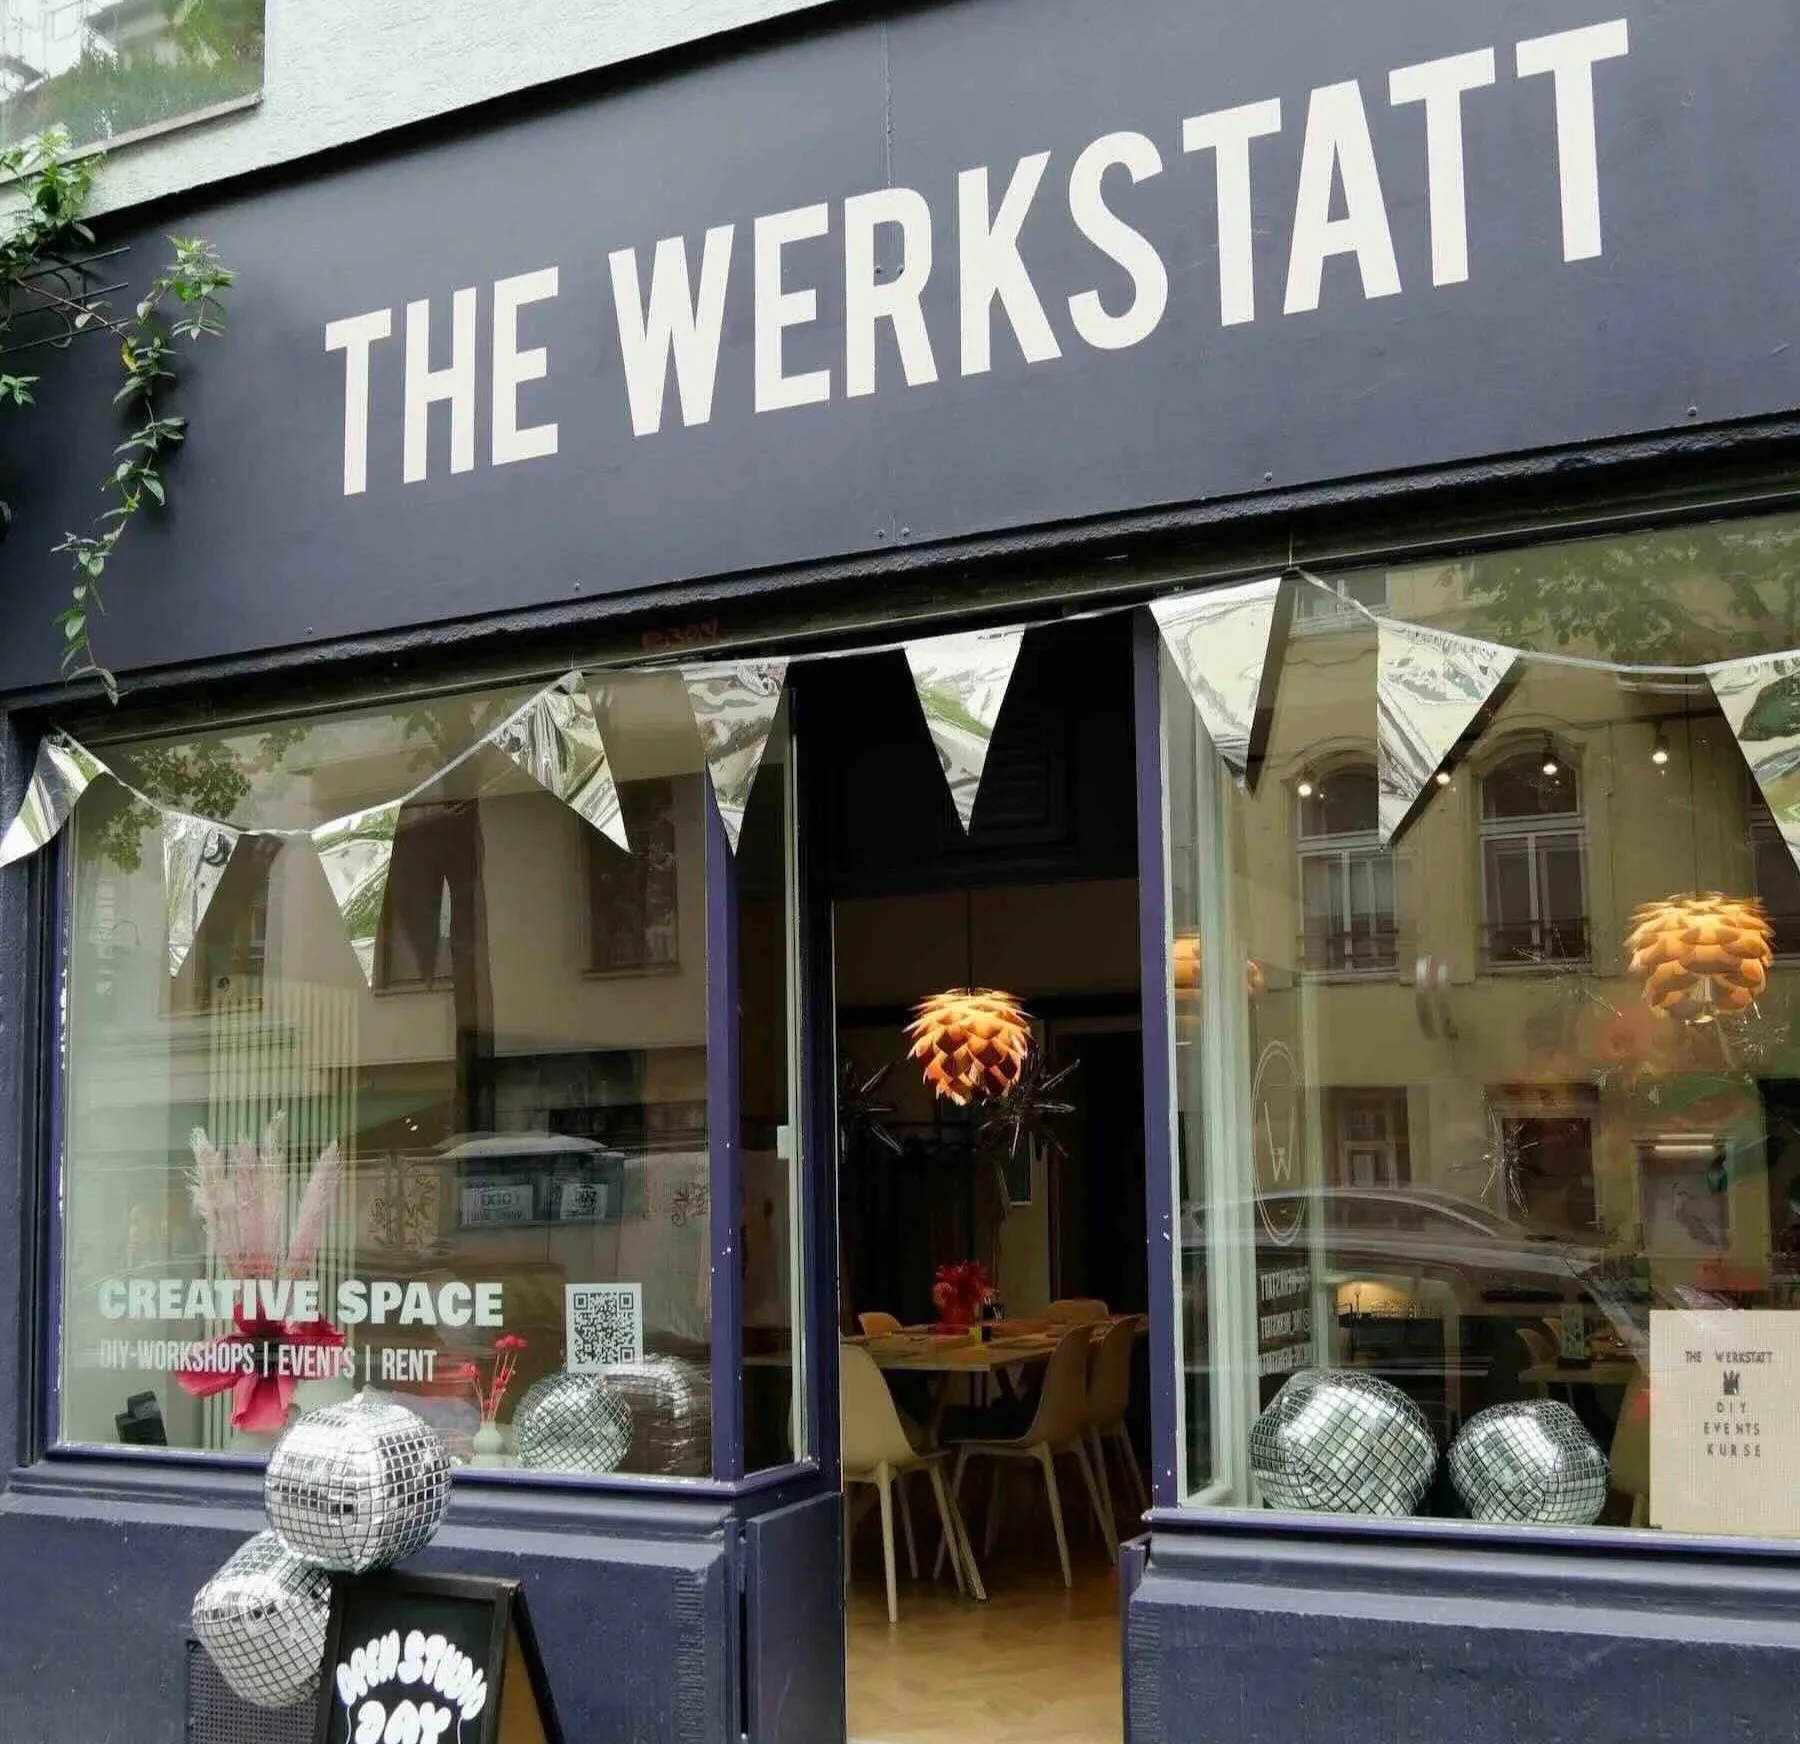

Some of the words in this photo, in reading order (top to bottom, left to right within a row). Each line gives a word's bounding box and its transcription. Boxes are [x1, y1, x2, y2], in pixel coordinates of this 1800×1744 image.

[325, 267, 558, 496] THE
[608, 18, 1629, 437] WERKSTATT
[99, 1279, 319, 1322] CREATIVE
[337, 1280, 504, 1326] SPACE
[101, 1339, 255, 1374] DIY-WORKSHOPS
[278, 1344, 355, 1378] EVENTS
[381, 1348, 437, 1382] RENT
[1685, 1350, 1702, 1363] THE
[1714, 1350, 1773, 1363] WERKSTATT
[1703, 1422, 1760, 1435] EVENTS
[1706, 1444, 1761, 1458] KURSE
[336, 1629, 400, 1706] OPEN
[398, 1629, 488, 1721] STUDIO
